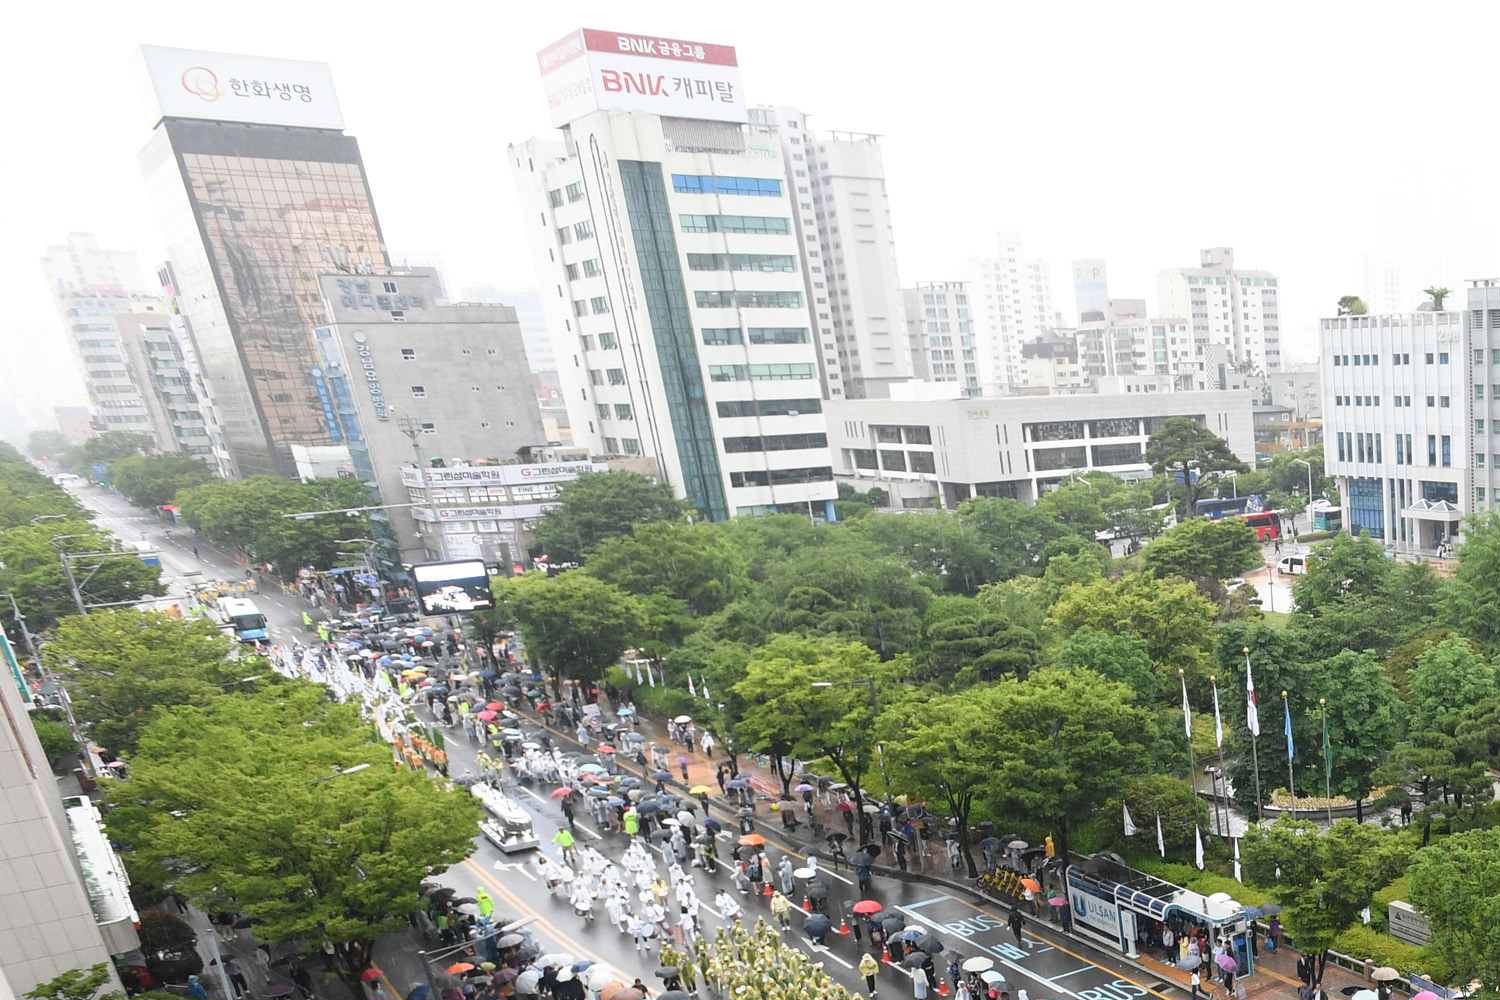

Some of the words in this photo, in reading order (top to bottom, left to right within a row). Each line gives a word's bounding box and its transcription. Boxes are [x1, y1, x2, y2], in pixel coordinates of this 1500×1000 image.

[617, 36, 657, 55] BNK
[658, 40, 706, 60] 금융그룹
[228, 78, 313, 103] 한화생명
[600, 68, 670, 97] BNK
[672, 76, 735, 104] 캐피탈
[357, 345, 389, 421] 강남요양병원
[433, 470, 500, 480] 그린섬미술학원
[521, 468, 531, 476] G
[1088, 901, 1117, 923] ULSAN
[945, 914, 1005, 937] BUS
[991, 937, 1055, 960] 버스
